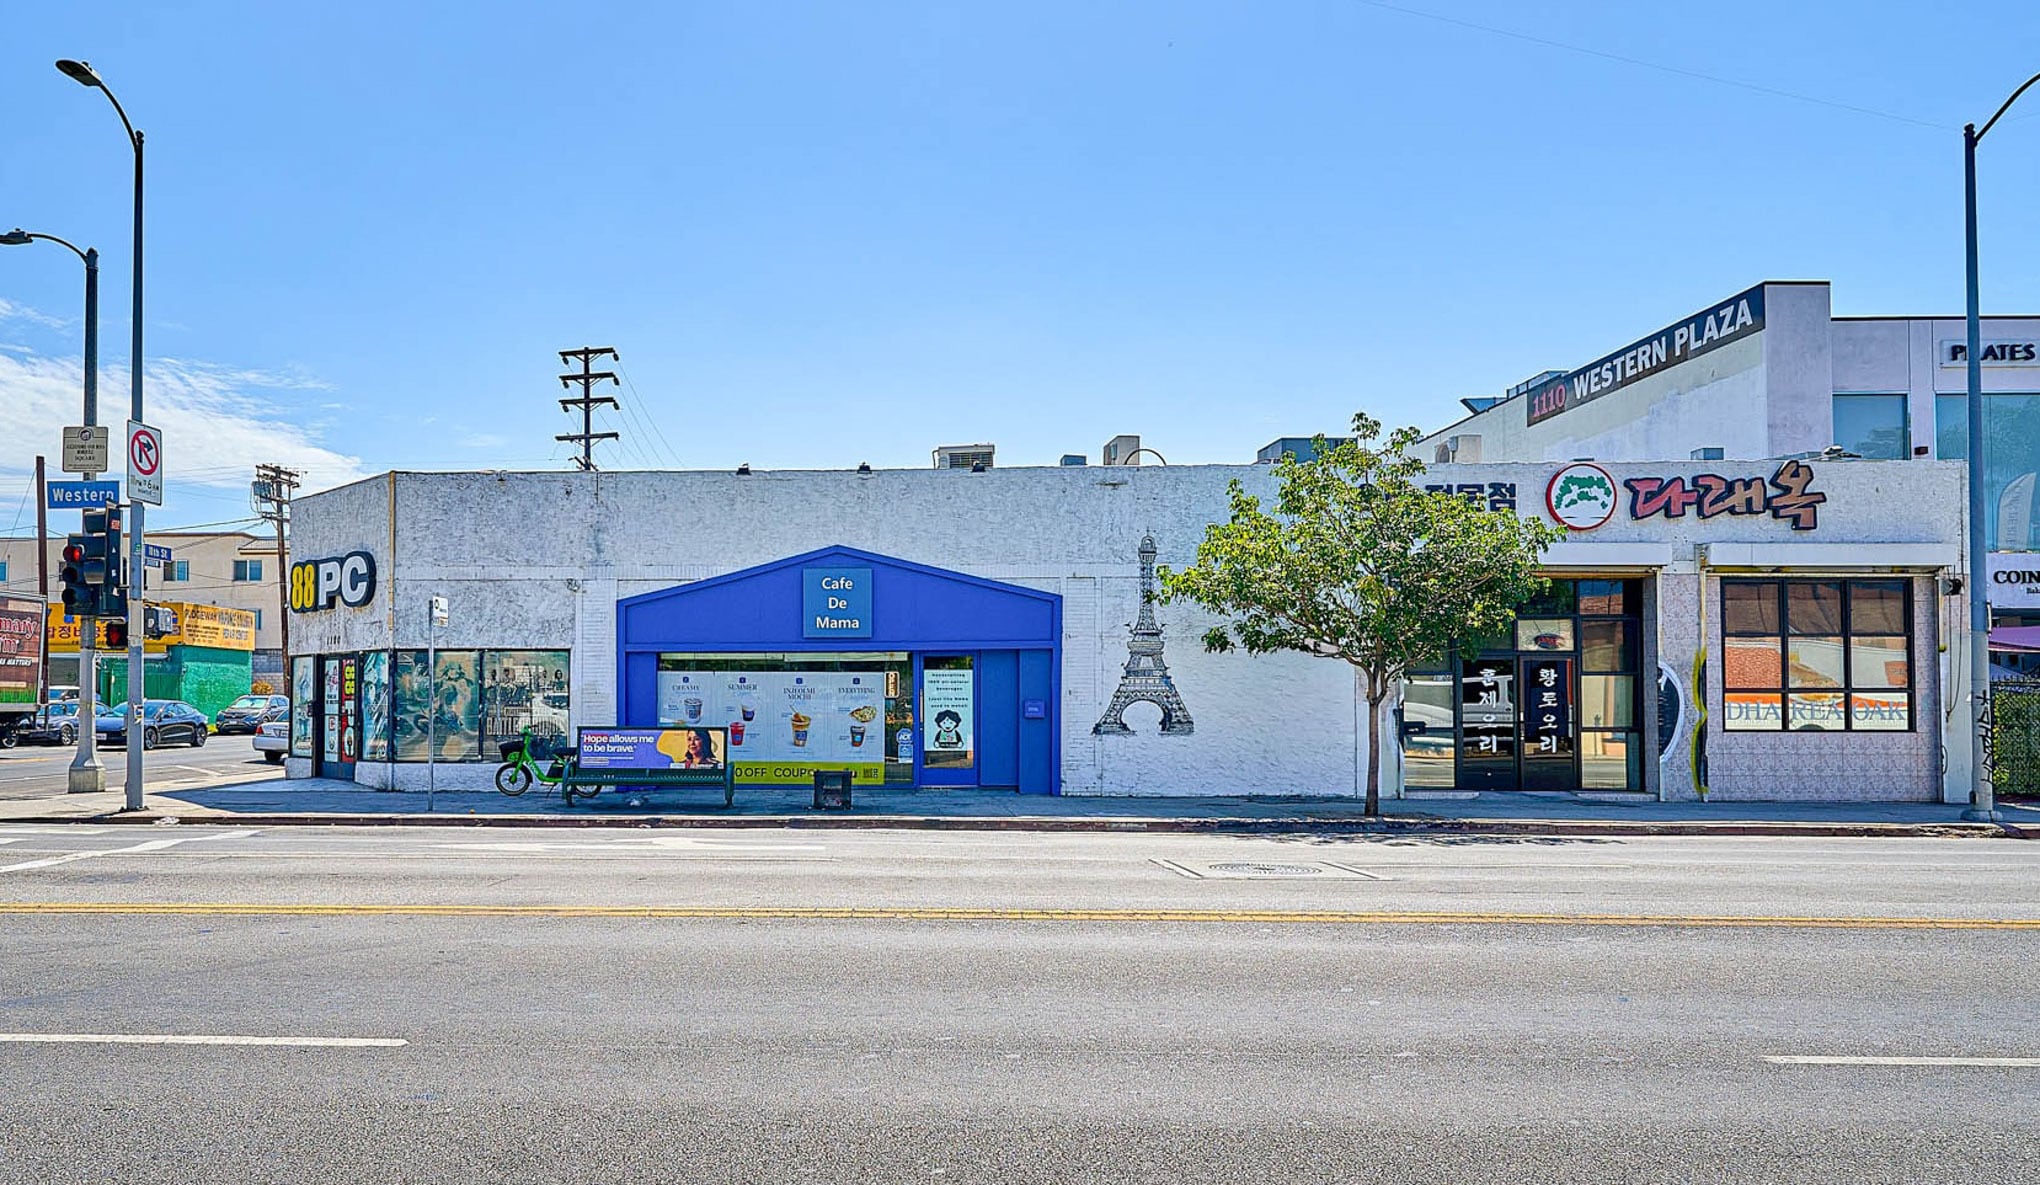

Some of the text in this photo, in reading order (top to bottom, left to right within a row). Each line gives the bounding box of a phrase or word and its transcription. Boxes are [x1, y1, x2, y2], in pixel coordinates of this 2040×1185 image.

[1532, 299, 1753, 418] 1110 WESTERN PLAZA
[52, 487, 114, 502] Western
[1624, 460, 1827, 530] 다래옥
[821, 577, 853, 590] Cafe
[828, 597, 847, 609] De
[816, 616, 860, 629] Mama
[1726, 700, 1905, 721] DHA REA OAK
[608, 733, 638, 743] allows
[639, 735, 654, 743] me
[583, 744, 593, 753] to
[593, 743, 605, 753] be
[745, 767, 767, 778] OFF
